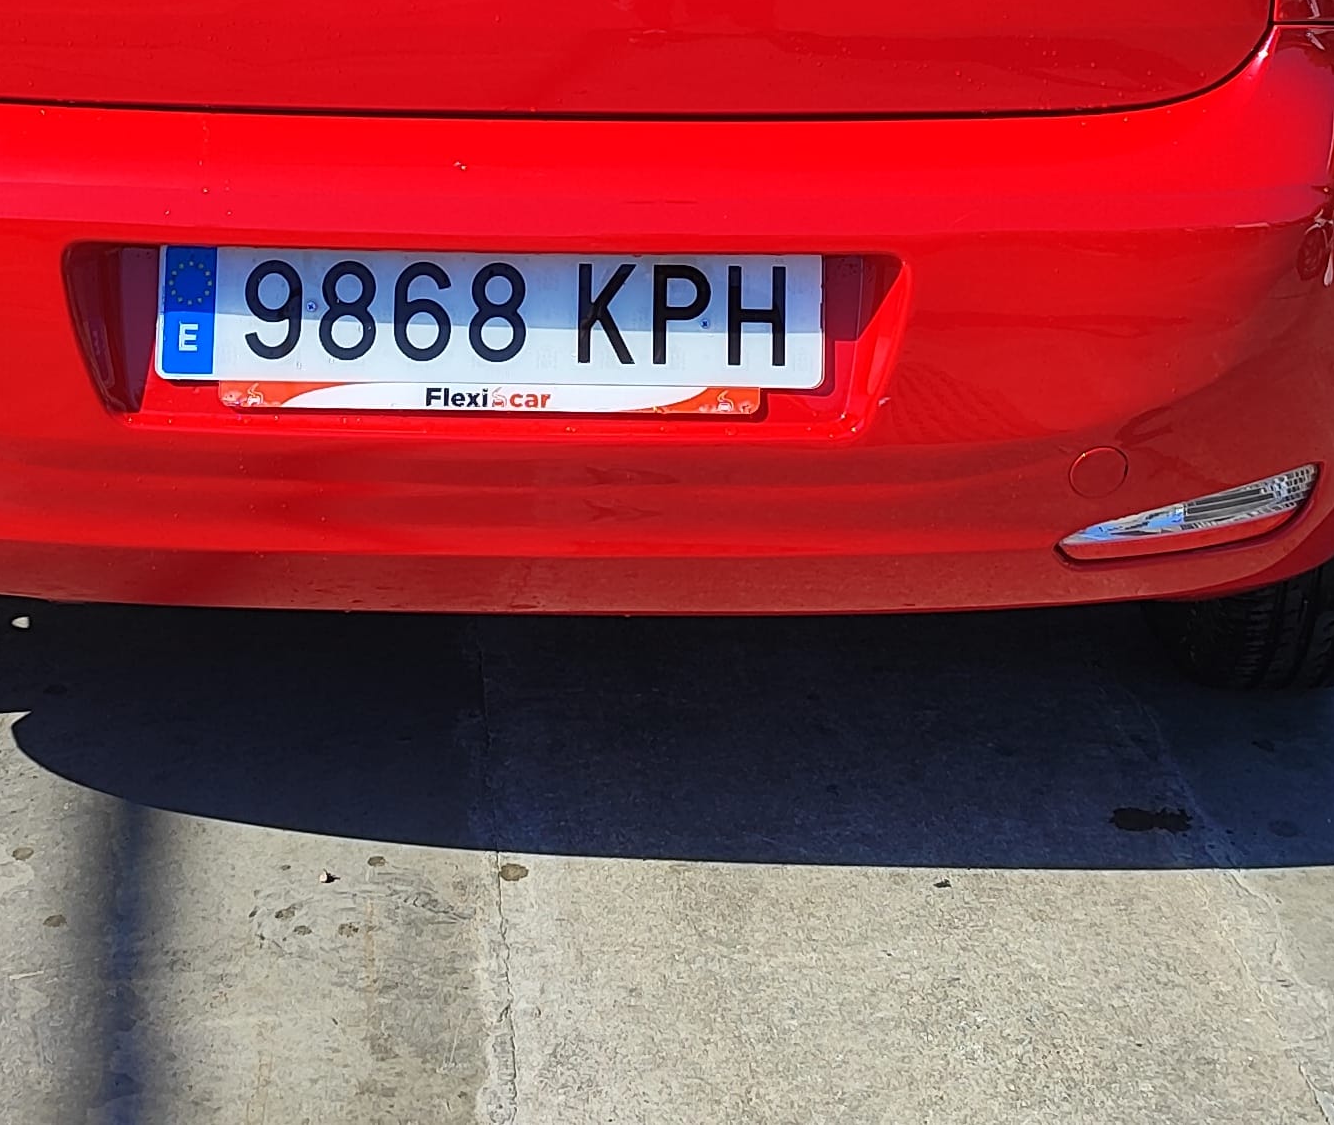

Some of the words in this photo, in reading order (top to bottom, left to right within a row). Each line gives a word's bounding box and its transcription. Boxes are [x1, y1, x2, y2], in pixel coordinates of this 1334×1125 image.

[178, 322, 199, 352] E
[244, 258, 527, 363] 9868
[577, 262, 787, 367] KPH
